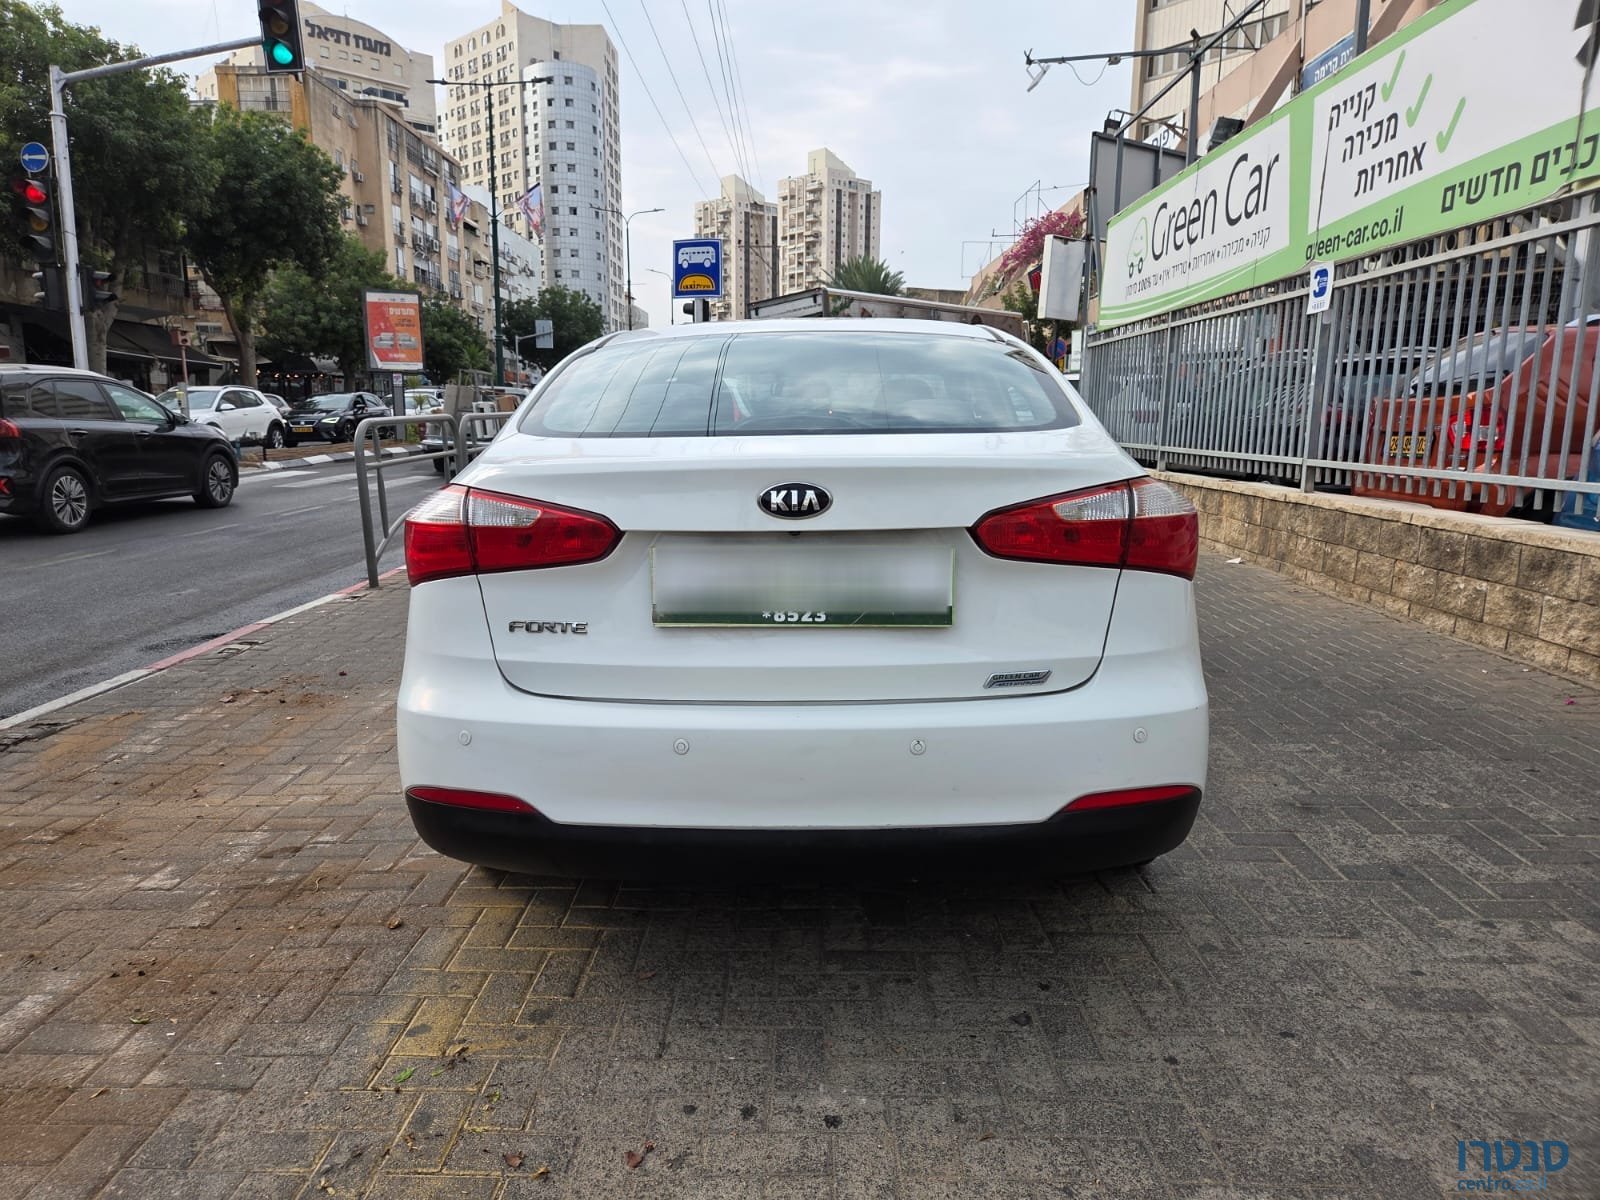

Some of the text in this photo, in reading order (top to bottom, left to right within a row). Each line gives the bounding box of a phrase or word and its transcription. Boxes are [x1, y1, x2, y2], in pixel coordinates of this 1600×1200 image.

[304, 19, 351, 46] דניאל
[1314, 56, 1339, 83] קדימה
[1328, 82, 1377, 131] קנייה
[1342, 112, 1399, 163] מכירה
[1354, 141, 1427, 197] אחריות
[1440, 161, 1522, 214] חדשים
[1151, 153, 1280, 261] Green Car
[1221, 237, 1244, 259] מכירה
[1250, 226, 1271, 249] קניה
[769, 489, 821, 512] KIA
[508, 621, 588, 635] FORTE
[992, 671, 1041, 681] GREEN CAR
